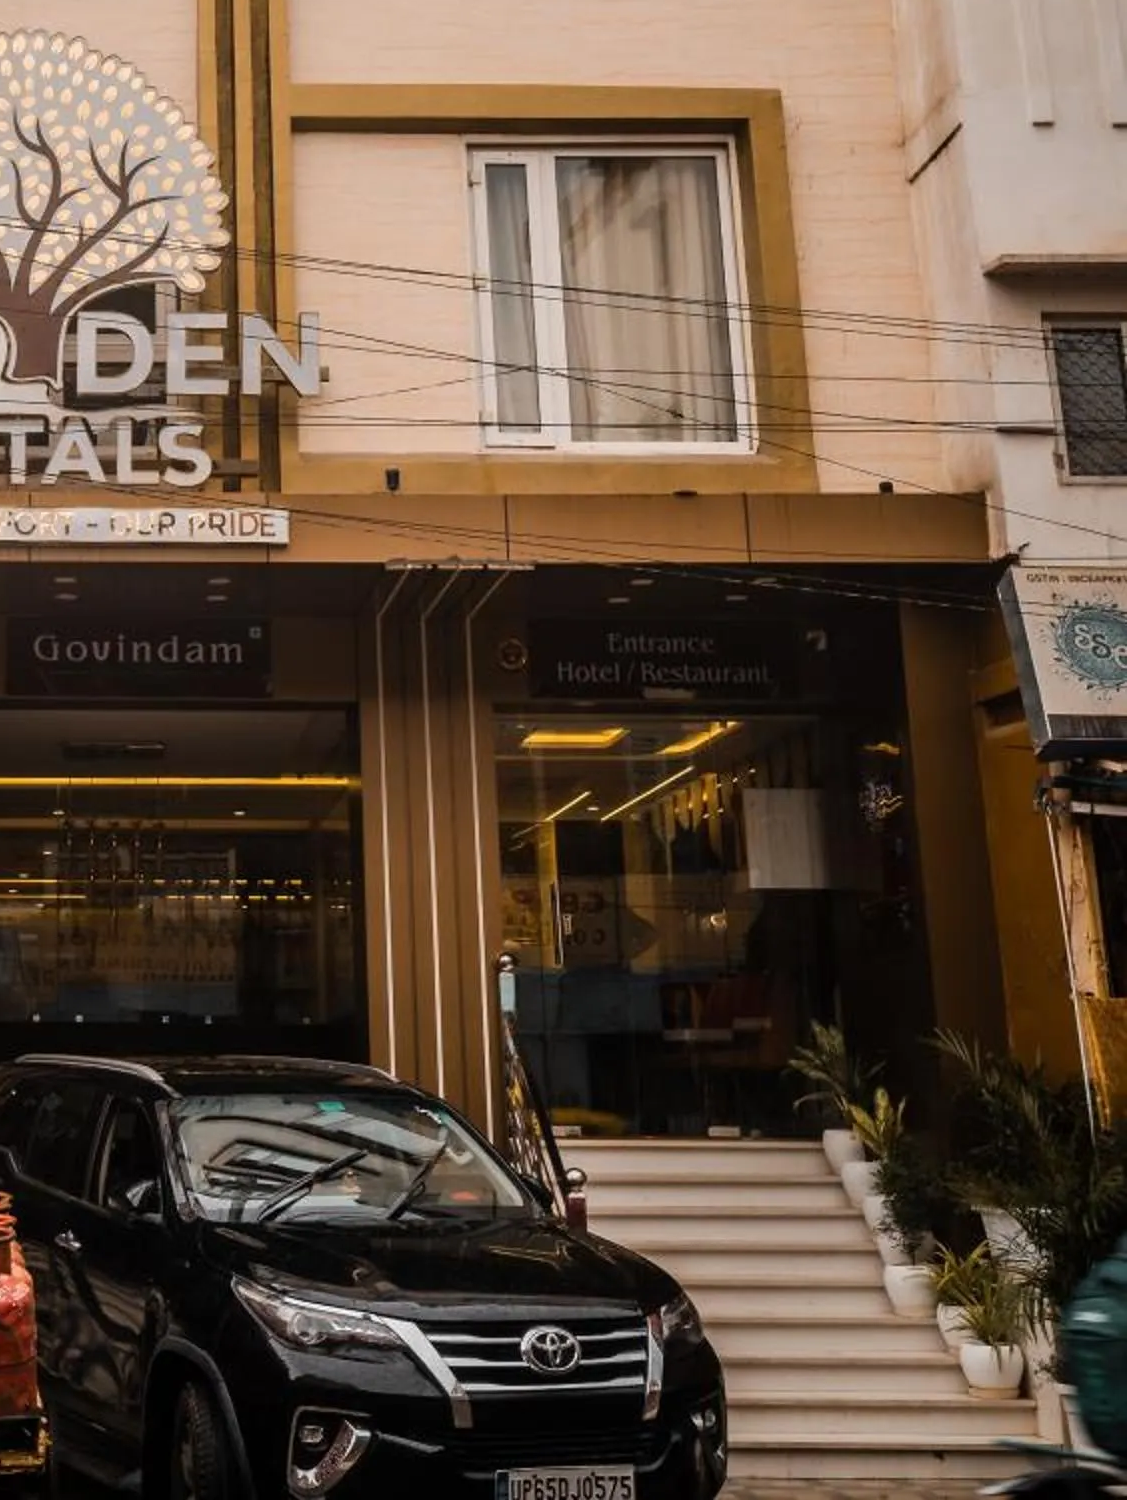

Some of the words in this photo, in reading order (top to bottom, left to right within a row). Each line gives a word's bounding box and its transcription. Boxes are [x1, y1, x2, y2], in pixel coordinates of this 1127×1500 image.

[188, 512, 277, 538] PRIDE
[33, 634, 244, 663] Govindam
[607, 632, 715, 654] Entrance
[557, 660, 621, 684] Hotel
[641, 660, 770, 685] Restaurant
